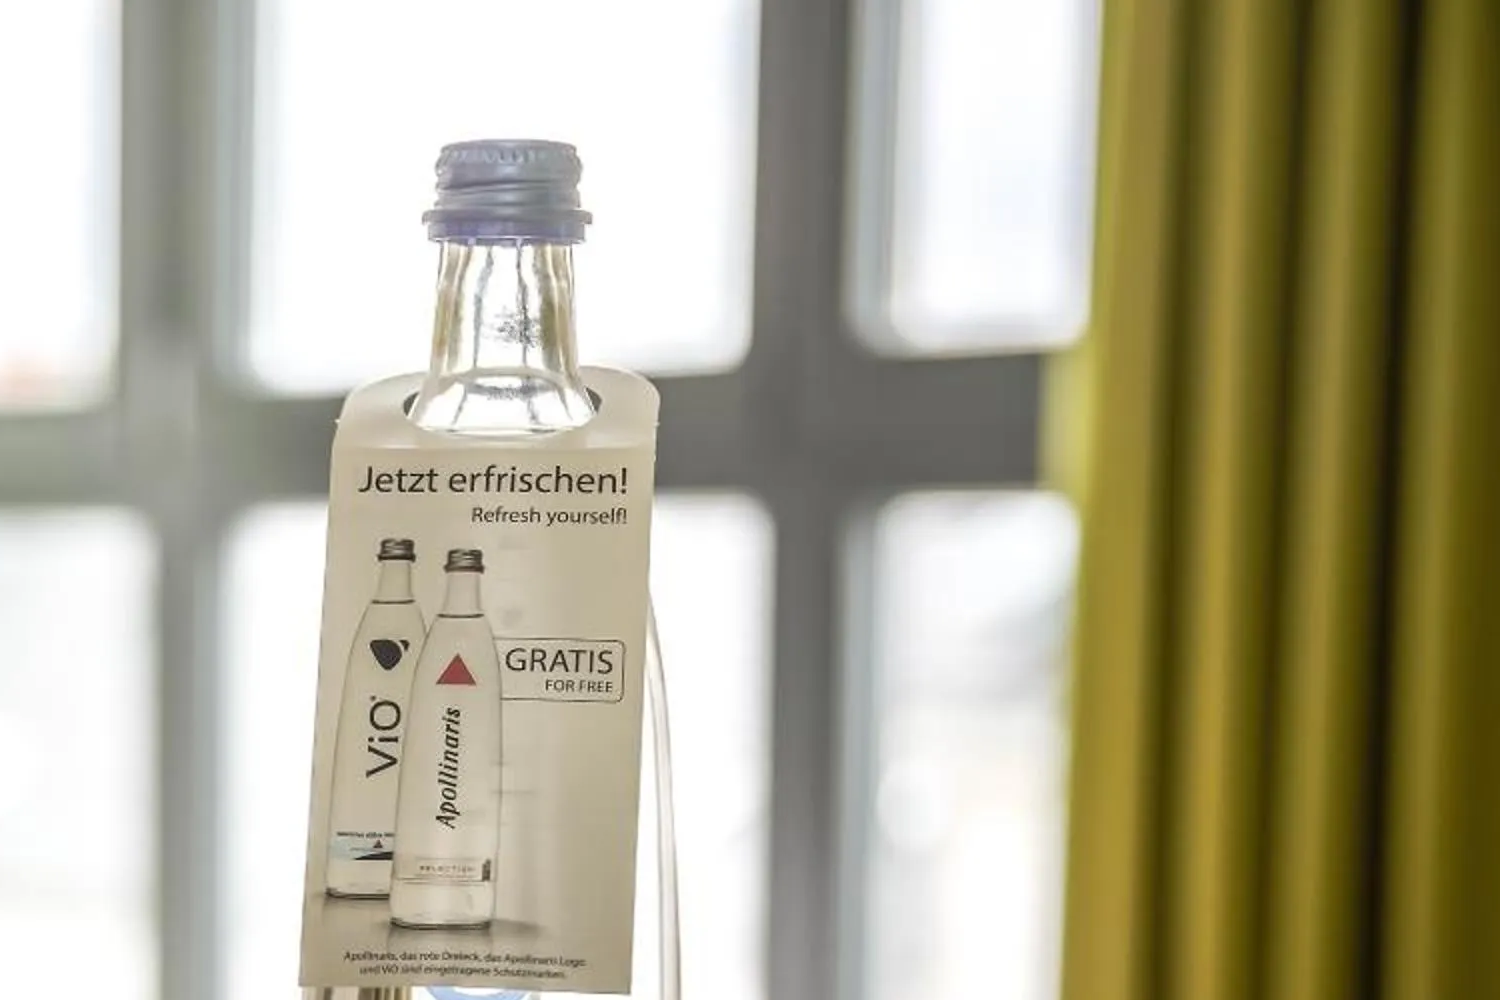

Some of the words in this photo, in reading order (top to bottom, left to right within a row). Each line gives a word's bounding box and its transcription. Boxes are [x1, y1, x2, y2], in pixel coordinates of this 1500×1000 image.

[358, 466, 438, 493] Jetzt
[448, 465, 628, 494] erfrischen!
[471, 506, 541, 524] Refresh
[547, 507, 628, 527] yourself!
[505, 648, 613, 674] GRATIS
[545, 679, 575, 693] FOR
[580, 680, 613, 693] FREE
[435, 707, 461, 829] Apollinaris
